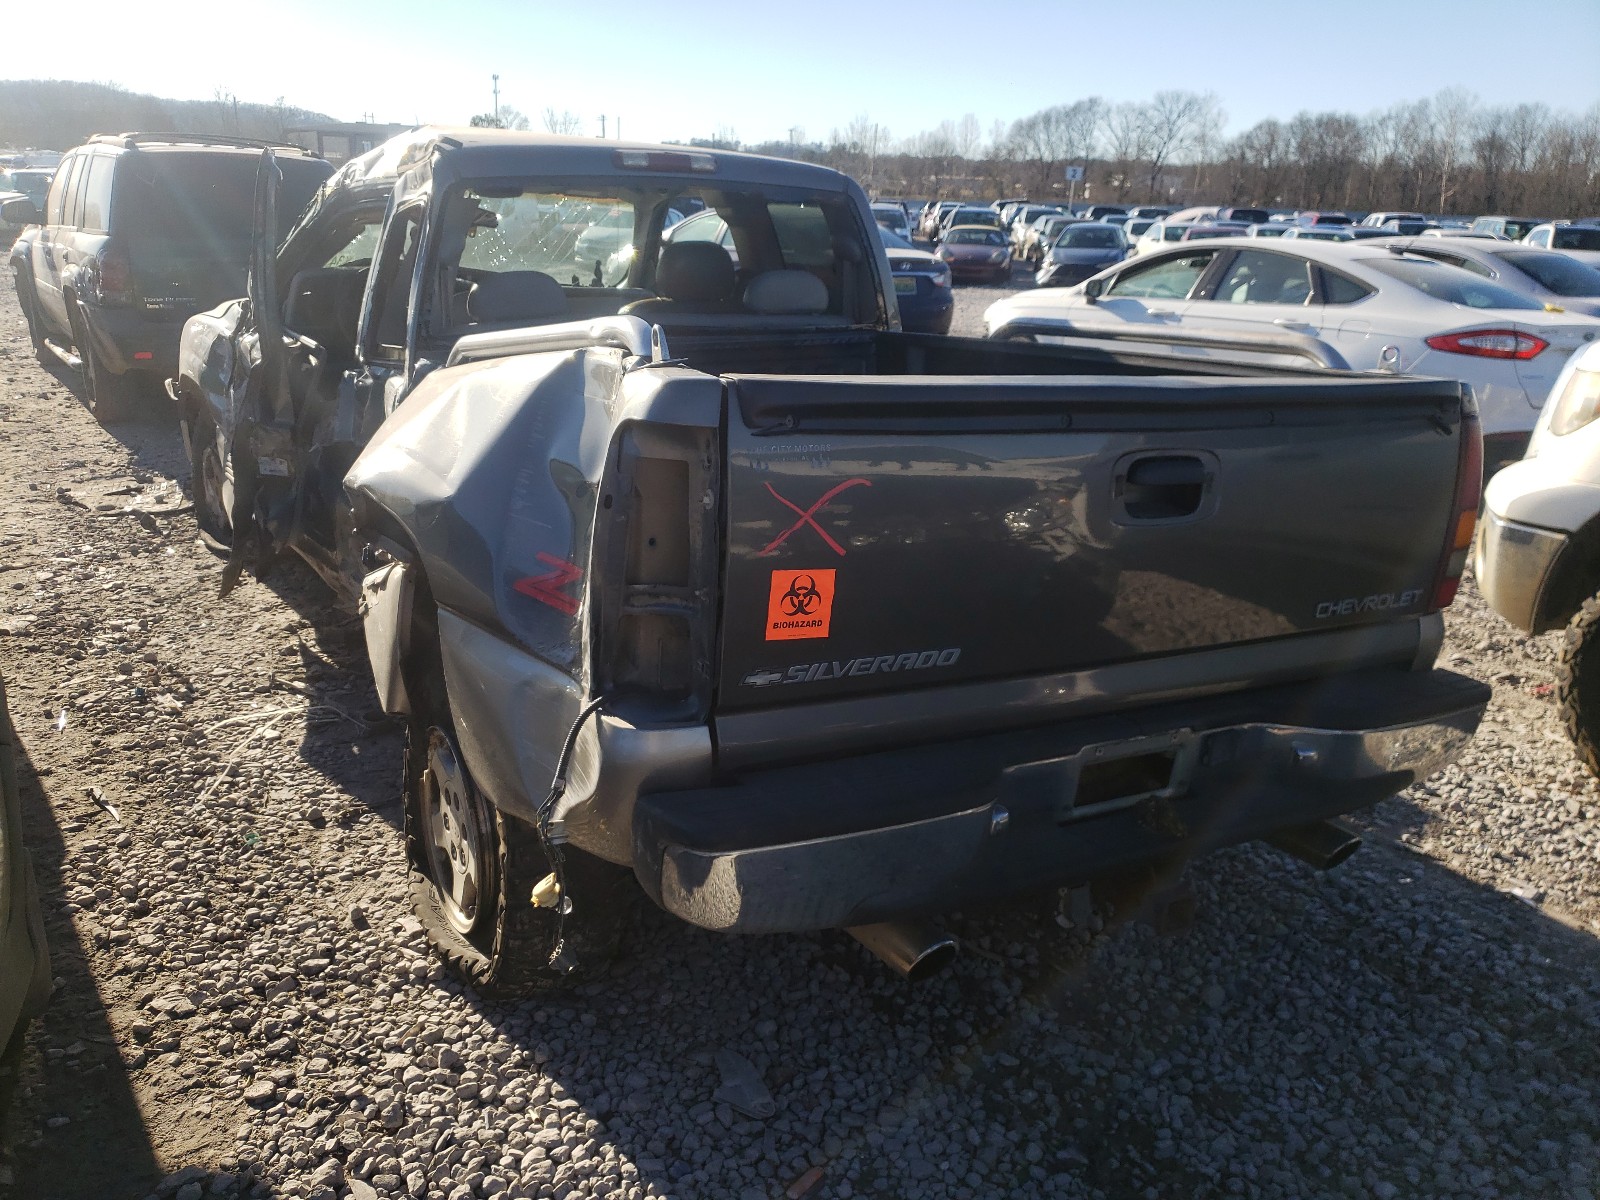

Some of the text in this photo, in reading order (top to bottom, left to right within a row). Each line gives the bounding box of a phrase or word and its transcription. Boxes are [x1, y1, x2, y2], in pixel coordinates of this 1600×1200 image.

[794, 443, 831, 453] MOTORS
[1316, 589, 1424, 618] CHEVROLET
[772, 619, 823, 630] BIOHAZARD
[783, 648, 962, 684] SILVERADO
